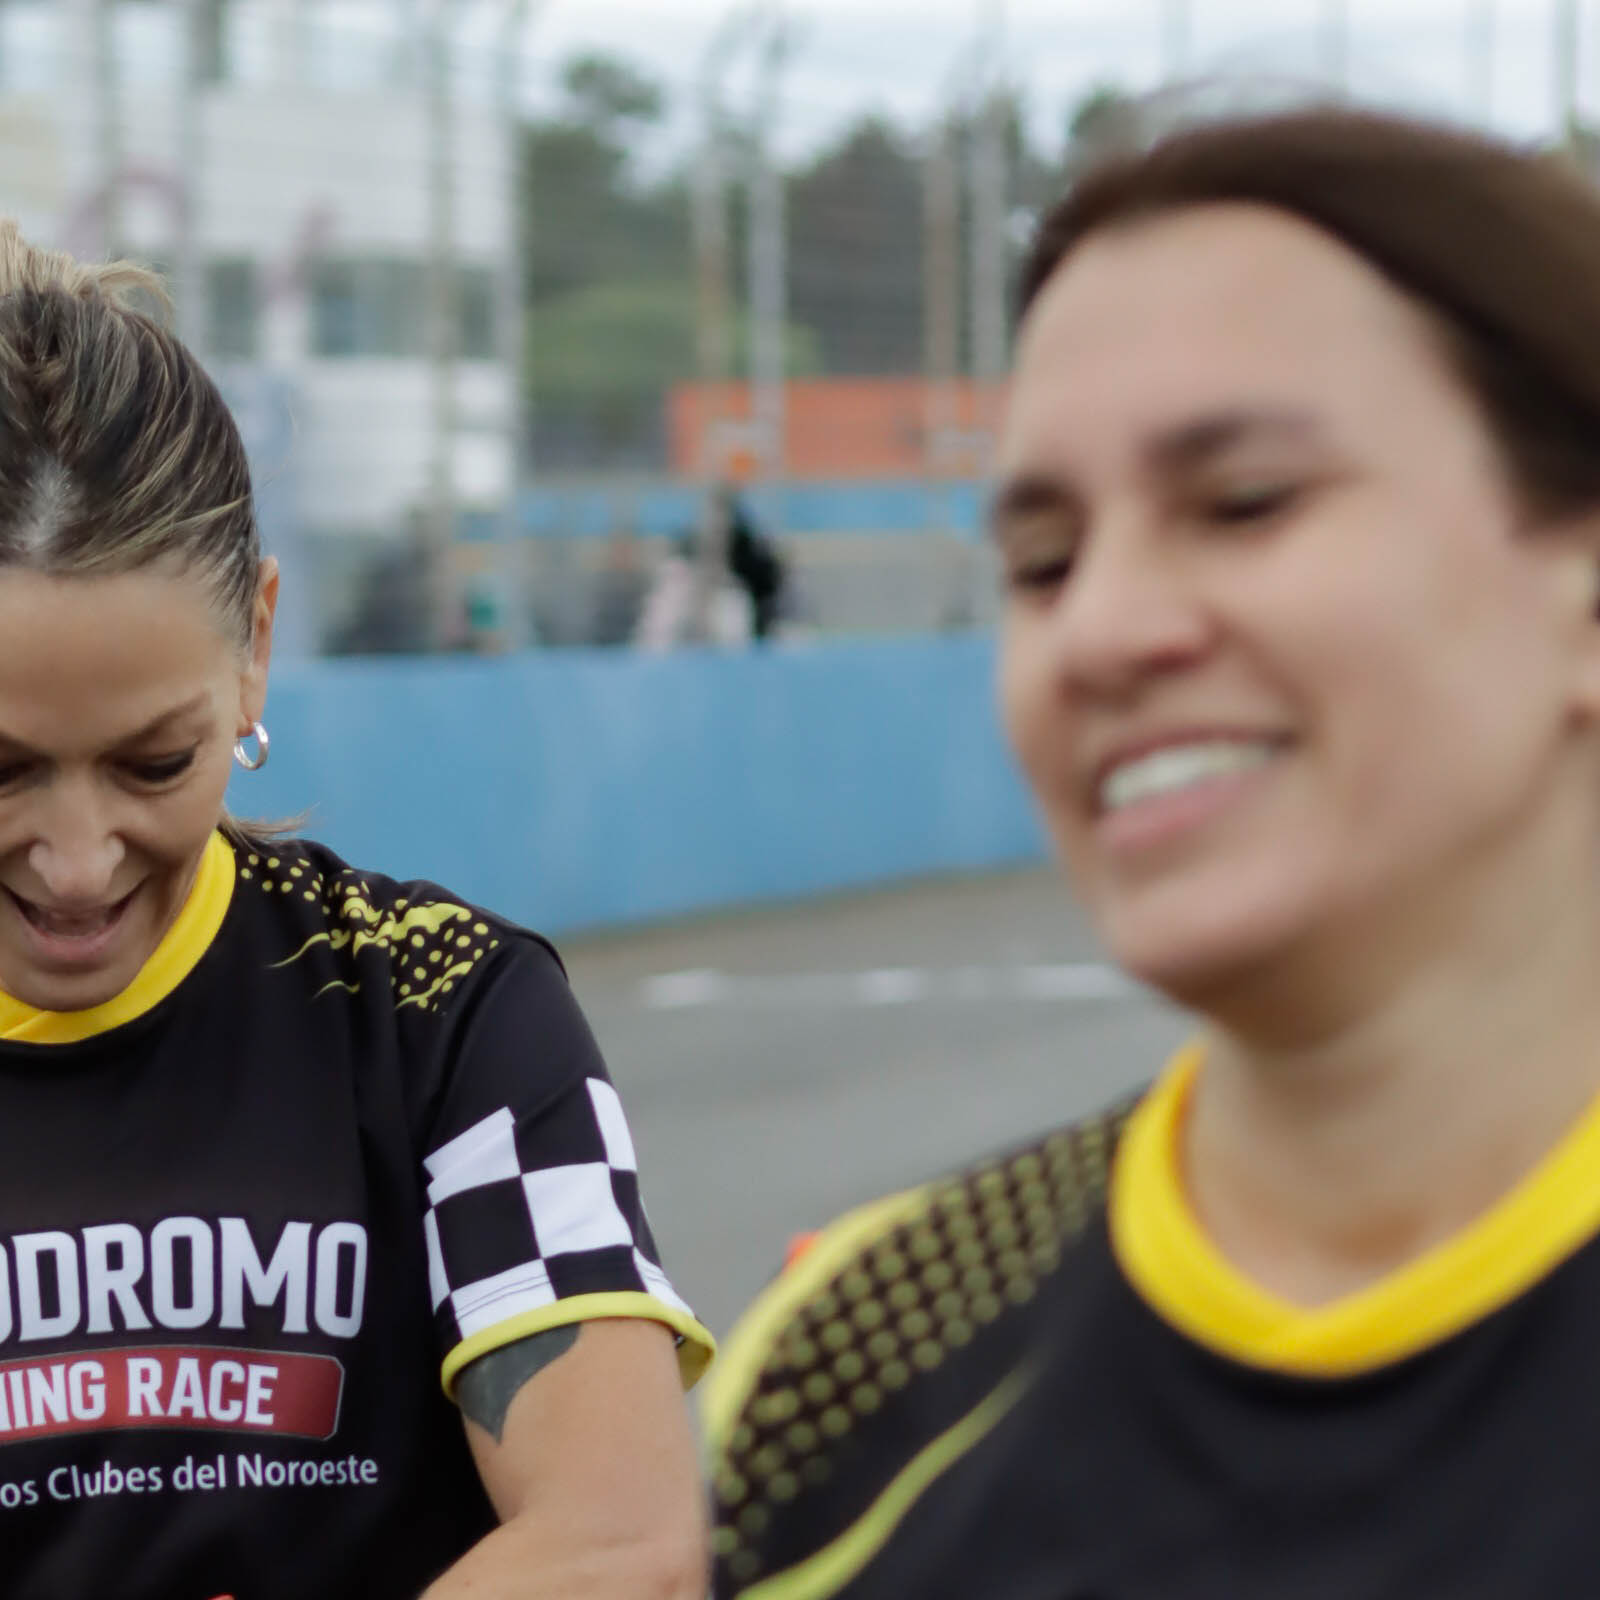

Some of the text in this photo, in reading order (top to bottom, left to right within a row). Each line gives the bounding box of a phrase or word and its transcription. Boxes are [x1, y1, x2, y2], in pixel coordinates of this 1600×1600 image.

[126, 1356, 279, 1426] RACE
[47, 1460, 164, 1500] Clubes
[172, 1454, 227, 1491] del
[236, 1453, 379, 1488] Noroeste
